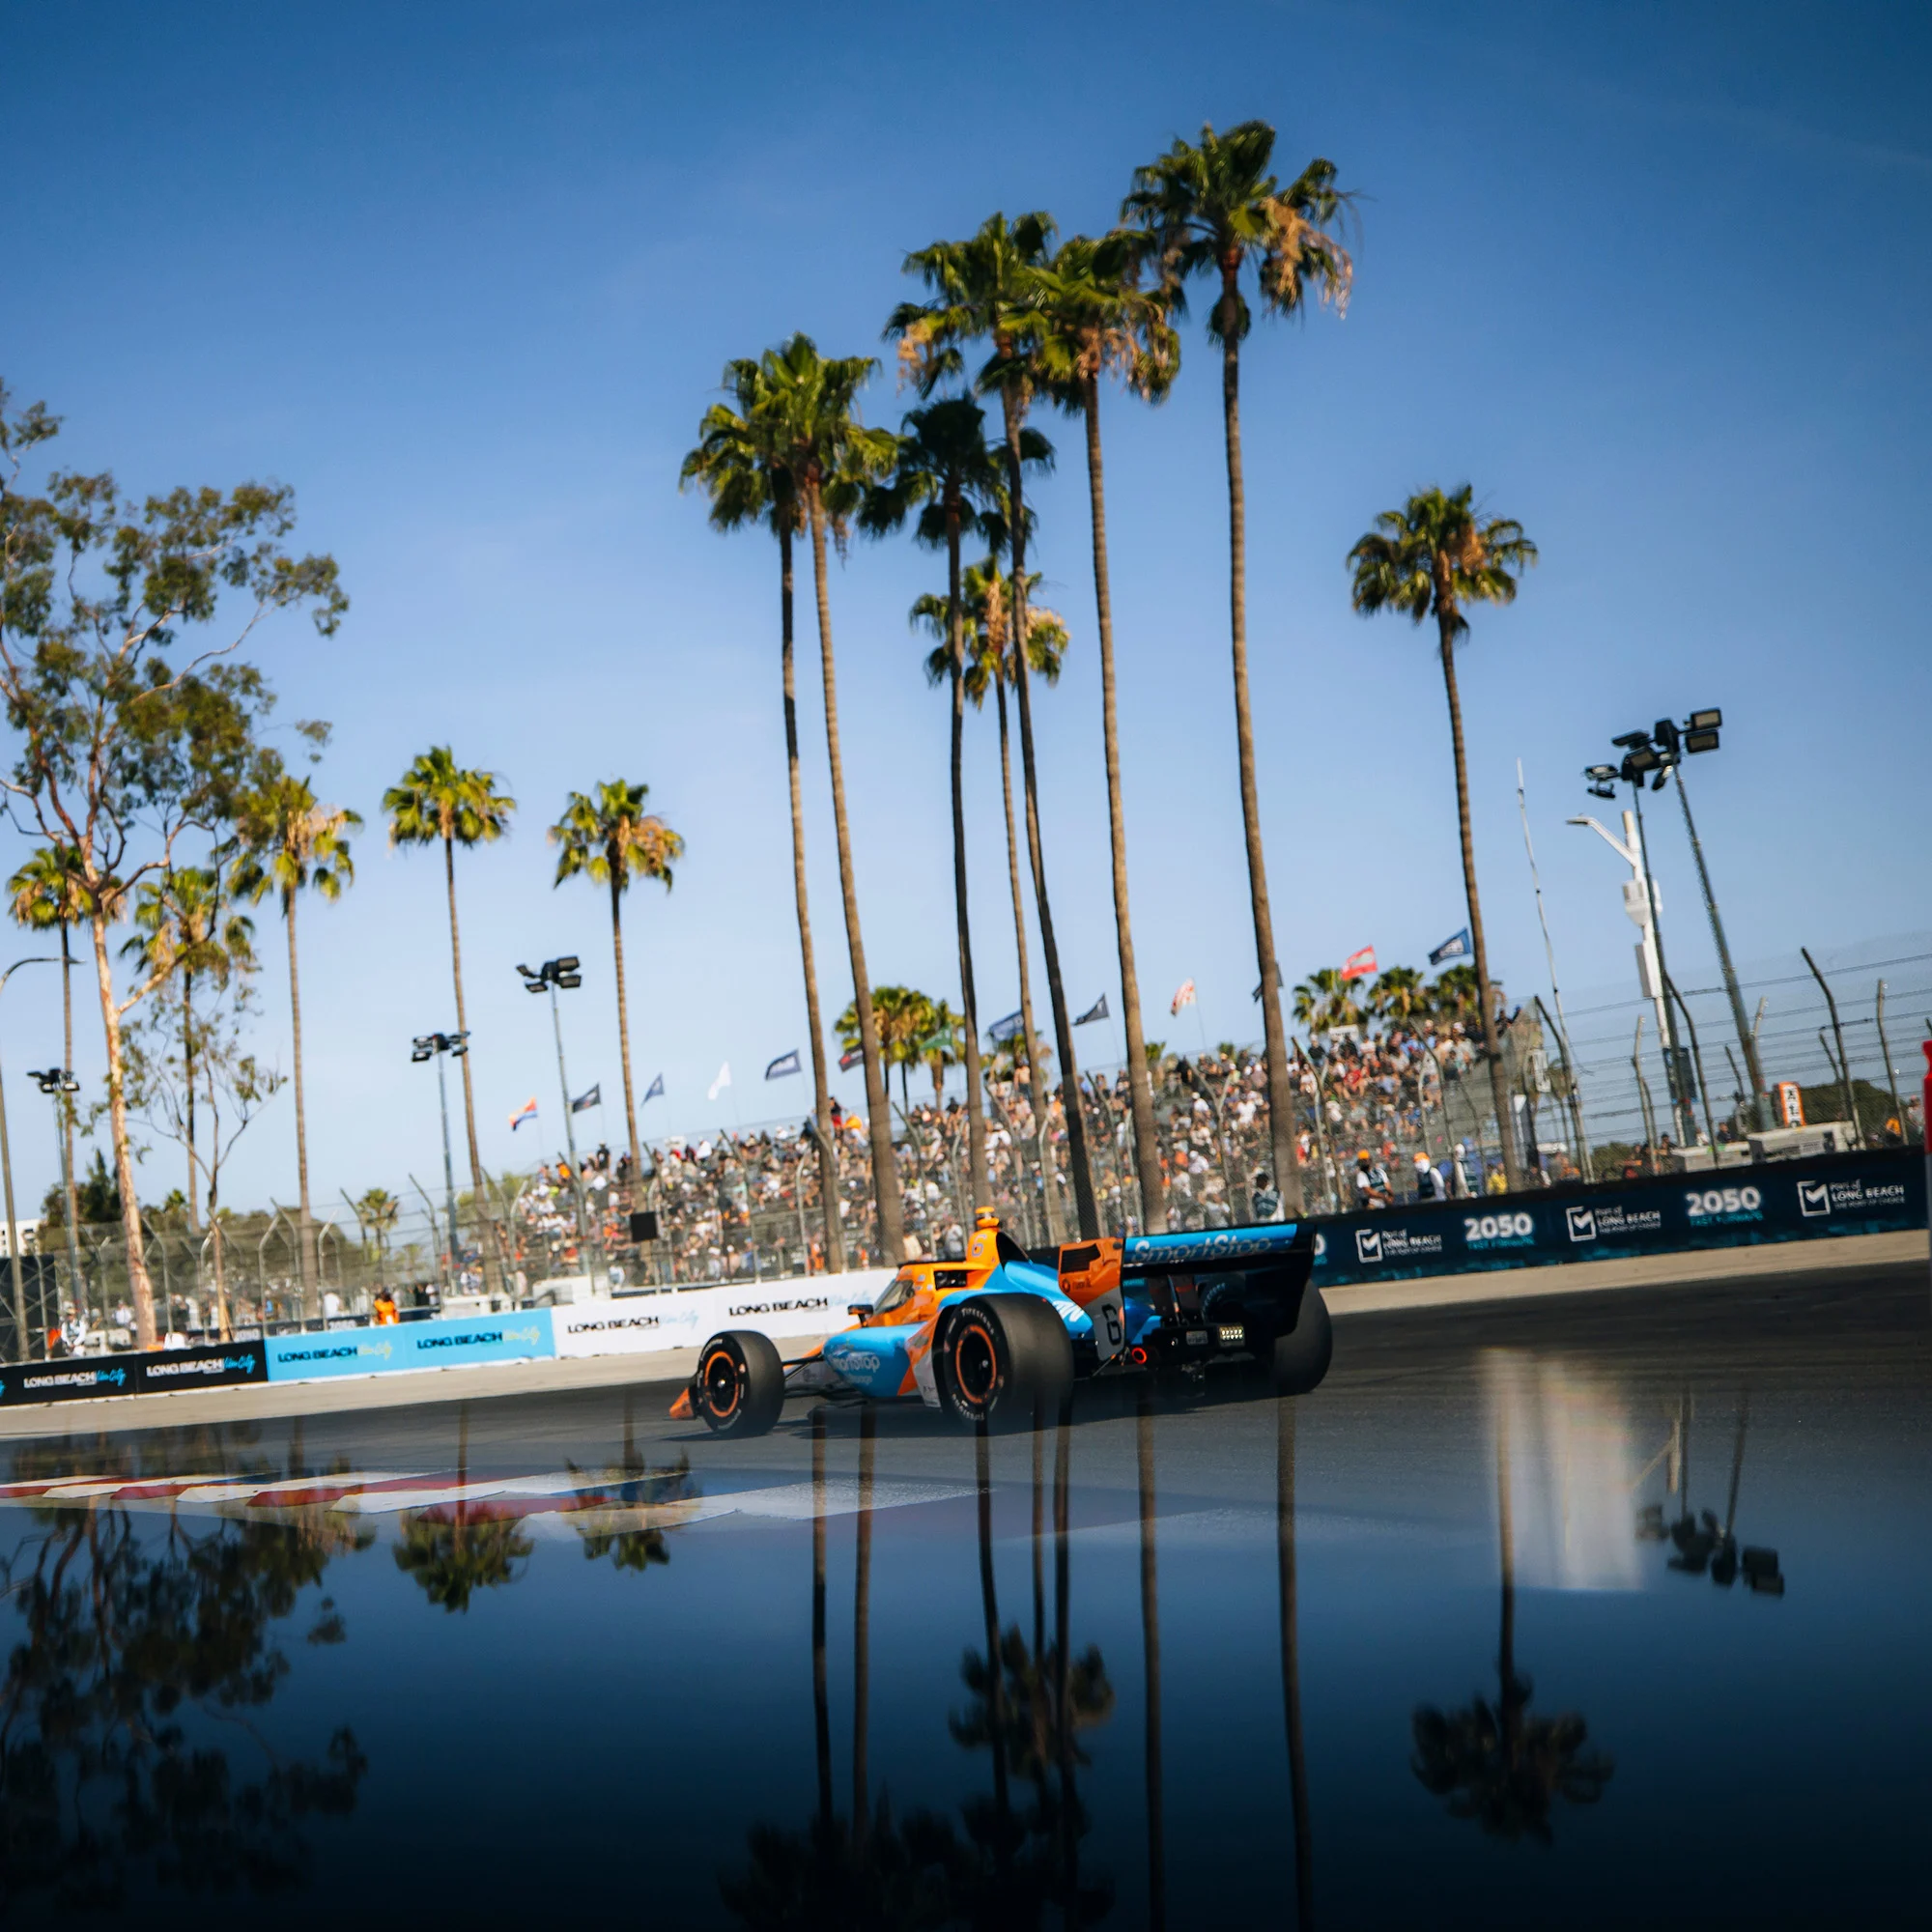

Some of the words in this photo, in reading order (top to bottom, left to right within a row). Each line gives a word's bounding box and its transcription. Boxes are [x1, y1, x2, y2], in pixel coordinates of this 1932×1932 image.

[1686, 1186, 1761, 1216] 2050
[1832, 1190, 1863, 1202] LONG
[1865, 1184, 1905, 1199] BEACH
[1463, 1212, 1533, 1241] 2050
[1597, 1215, 1625, 1227] LONG
[1627, 1210, 1661, 1224] BEACH
[972, 1234, 987, 1257] 6
[1409, 1235, 1441, 1246] BEACH
[729, 1302, 770, 1316] LONG
[773, 1297, 828, 1311] BEACH
[568, 1321, 605, 1333] LONG
[608, 1316, 659, 1329] BEACH
[1101, 1303, 1122, 1346] 6
[415, 1338, 453, 1350] LONG
[455, 1332, 502, 1346] BEACH
[277, 1351, 311, 1363] LONG
[313, 1347, 357, 1360] BEACH
[146, 1363, 180, 1377] LONG
[180, 1358, 223, 1373] BEACH
[23, 1376, 54, 1388] LONG
[55, 1372, 96, 1385] BEACH
